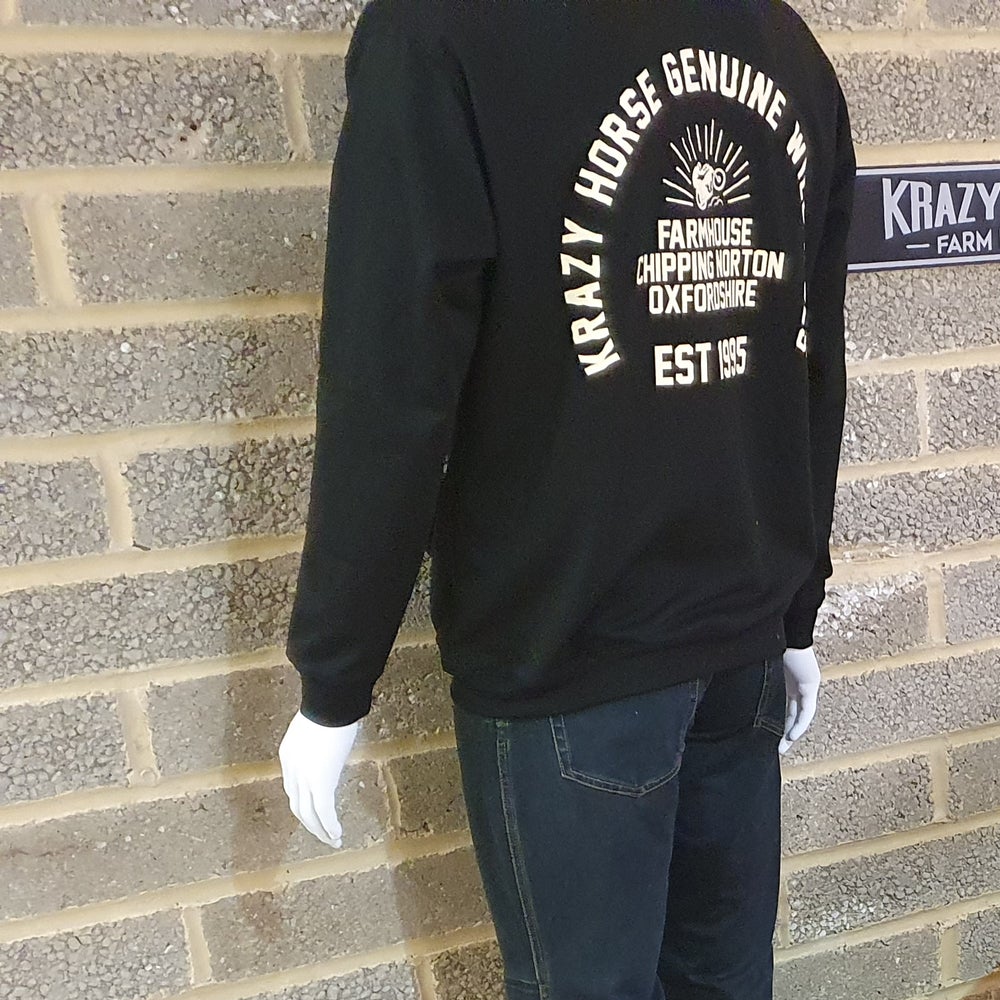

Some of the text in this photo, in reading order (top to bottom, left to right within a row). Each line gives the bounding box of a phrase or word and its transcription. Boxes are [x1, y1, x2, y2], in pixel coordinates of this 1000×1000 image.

[661, 47, 787, 131] GENUINE
[574, 68, 663, 207] HORSE
[657, 218, 753, 249] FARMHOUSE
[937, 228, 993, 254] FARM
[636, 248, 785, 285] CHIPPING NORTON
[560, 217, 621, 377] KRAZY
[648, 280, 758, 315] OXFORDSHIRE
[654, 335, 748, 387] EST 1995
